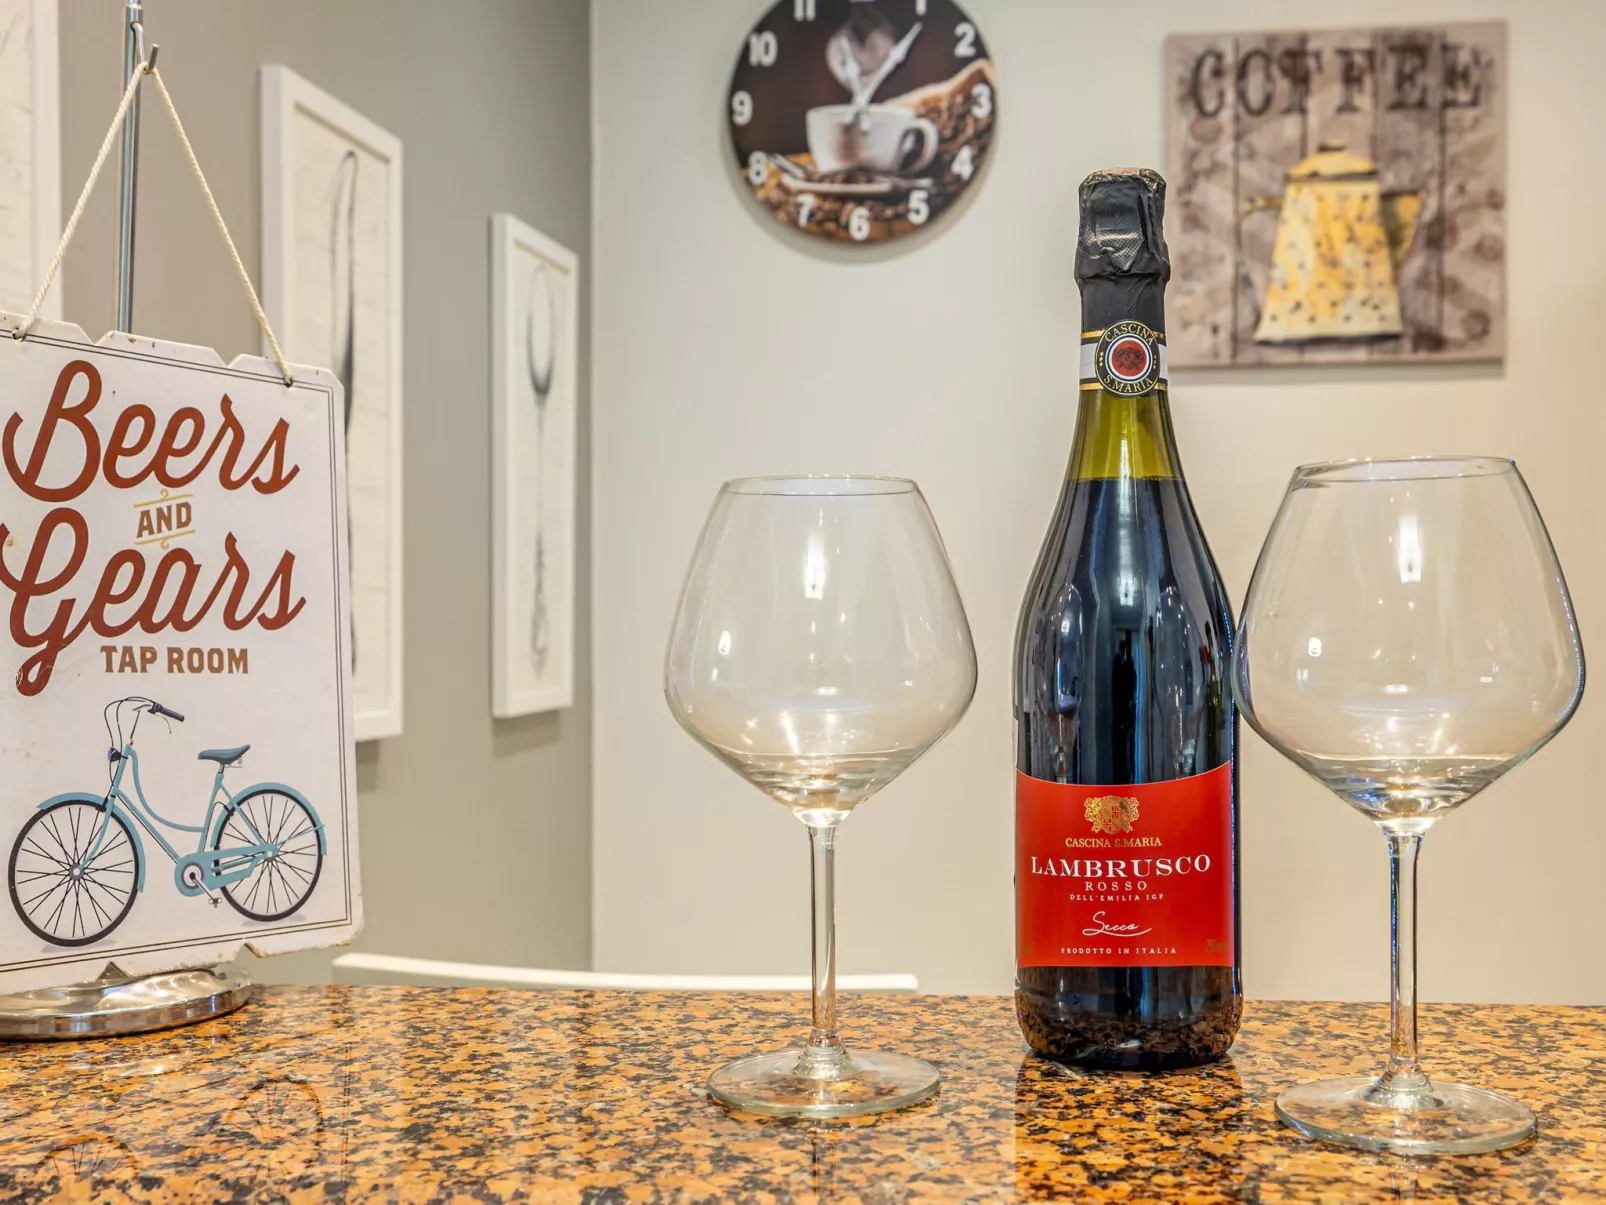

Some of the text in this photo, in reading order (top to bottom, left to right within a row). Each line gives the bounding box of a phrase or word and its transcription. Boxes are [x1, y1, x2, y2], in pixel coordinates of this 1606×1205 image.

[749, 30, 778, 67] 10
[954, 22, 976, 58] 2
[1190, 44, 1484, 117] COFFEE
[732, 90, 753, 126] 9
[971, 83, 992, 119] 3
[748, 151, 768, 186] 8
[951, 145, 973, 181] 4
[799, 194, 815, 227] 7
[849, 207, 870, 241] 6
[907, 190, 929, 225] 5
[1105, 323, 1154, 345] CASCINA
[1104, 374, 1153, 393] S.MARIA
[2, 359, 301, 503] Beers
[136, 501, 192, 538] AND
[0, 507, 307, 697] Gears
[100, 645, 249, 674] TAP ROOM
[1065, 837, 1162, 848] CASCINA S.MARIA
[1031, 854, 1211, 878] LAMBRUSCO
[1070, 893, 1140, 901] DELL'EMILIA
[1085, 881, 1147, 891] ROSSO
[1082, 911, 1152, 937] Secco
